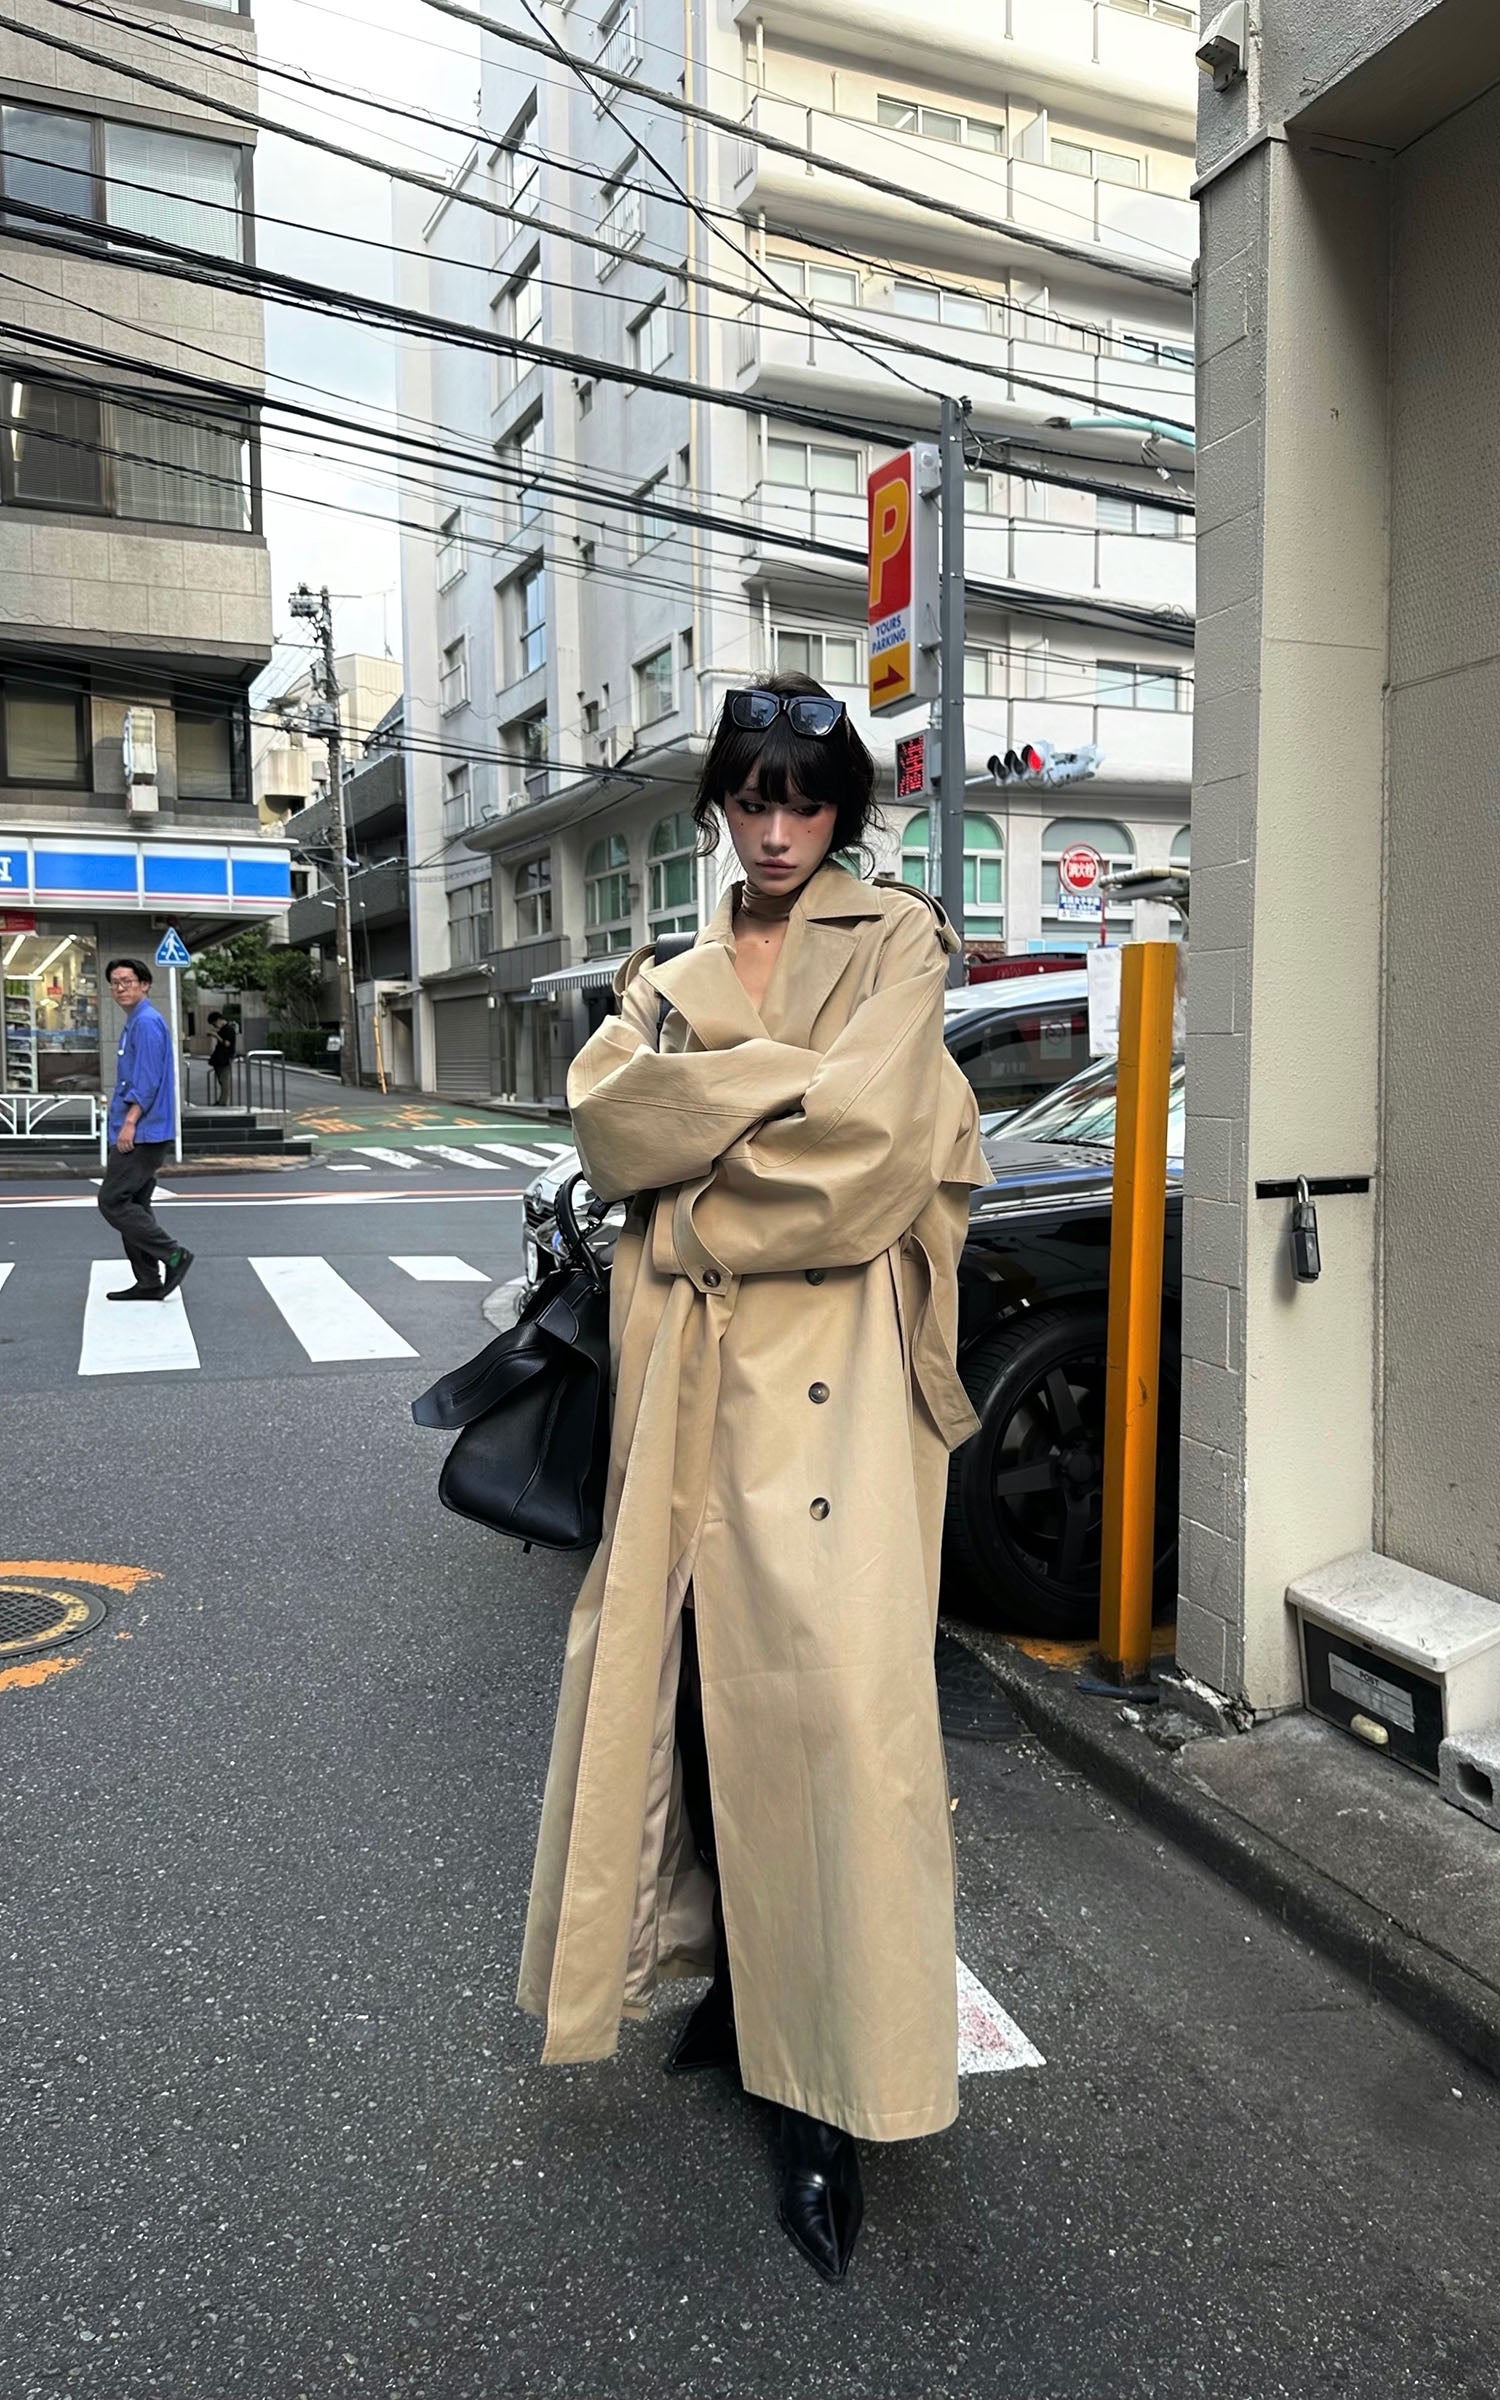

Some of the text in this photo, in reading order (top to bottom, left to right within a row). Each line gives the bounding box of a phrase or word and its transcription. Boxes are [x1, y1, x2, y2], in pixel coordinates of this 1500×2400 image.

[869, 478, 909, 608] P
[876, 615, 902, 637] YOURS
[872, 628, 906, 654] PARKING
[1359, 1671, 1379, 1686] POST
